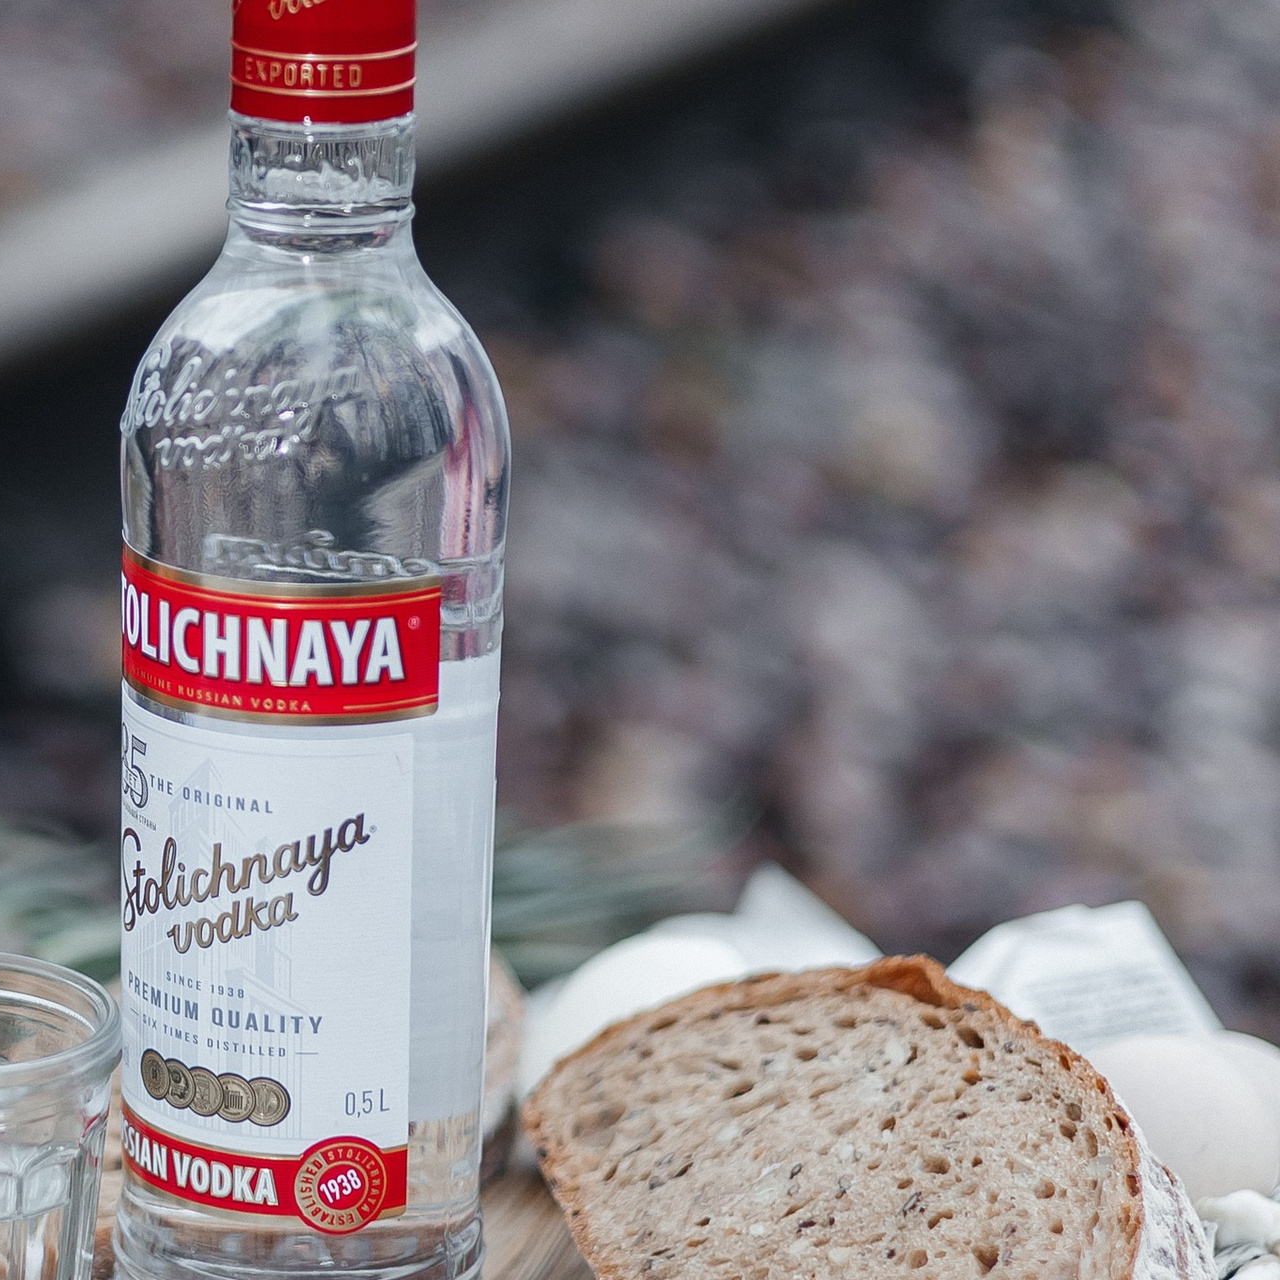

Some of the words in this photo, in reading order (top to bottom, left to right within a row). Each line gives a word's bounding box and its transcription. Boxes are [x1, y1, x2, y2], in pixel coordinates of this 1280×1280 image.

[243, 57, 363, 88] EXPORTED
[177, 684, 243, 708] RUSSIAN
[250, 697, 312, 713] VODKA
[150, 773, 174, 796] THE
[182, 786, 274, 815] ORIGINAL
[121, 813, 370, 932] Stolichnaya
[167, 893, 299, 954] vodka
[128, 970, 199, 1021] PREMIUM
[211, 1007, 323, 1035] QUALITY
[166, 970, 201, 991] SINCE
[210, 983, 245, 1000] 1938
[142, 1013, 157, 1031] SIX
[163, 1023, 199, 1045] TIMES
[207, 1037, 286, 1058] DISTILLED
[345, 1091, 373, 1118] 0,5
[379, 1089, 390, 1113] L
[172, 1151, 280, 1206] VODKA
[300, 1158, 356, 1226] ESTABLISHED
[319, 1168, 362, 1204] 1938
